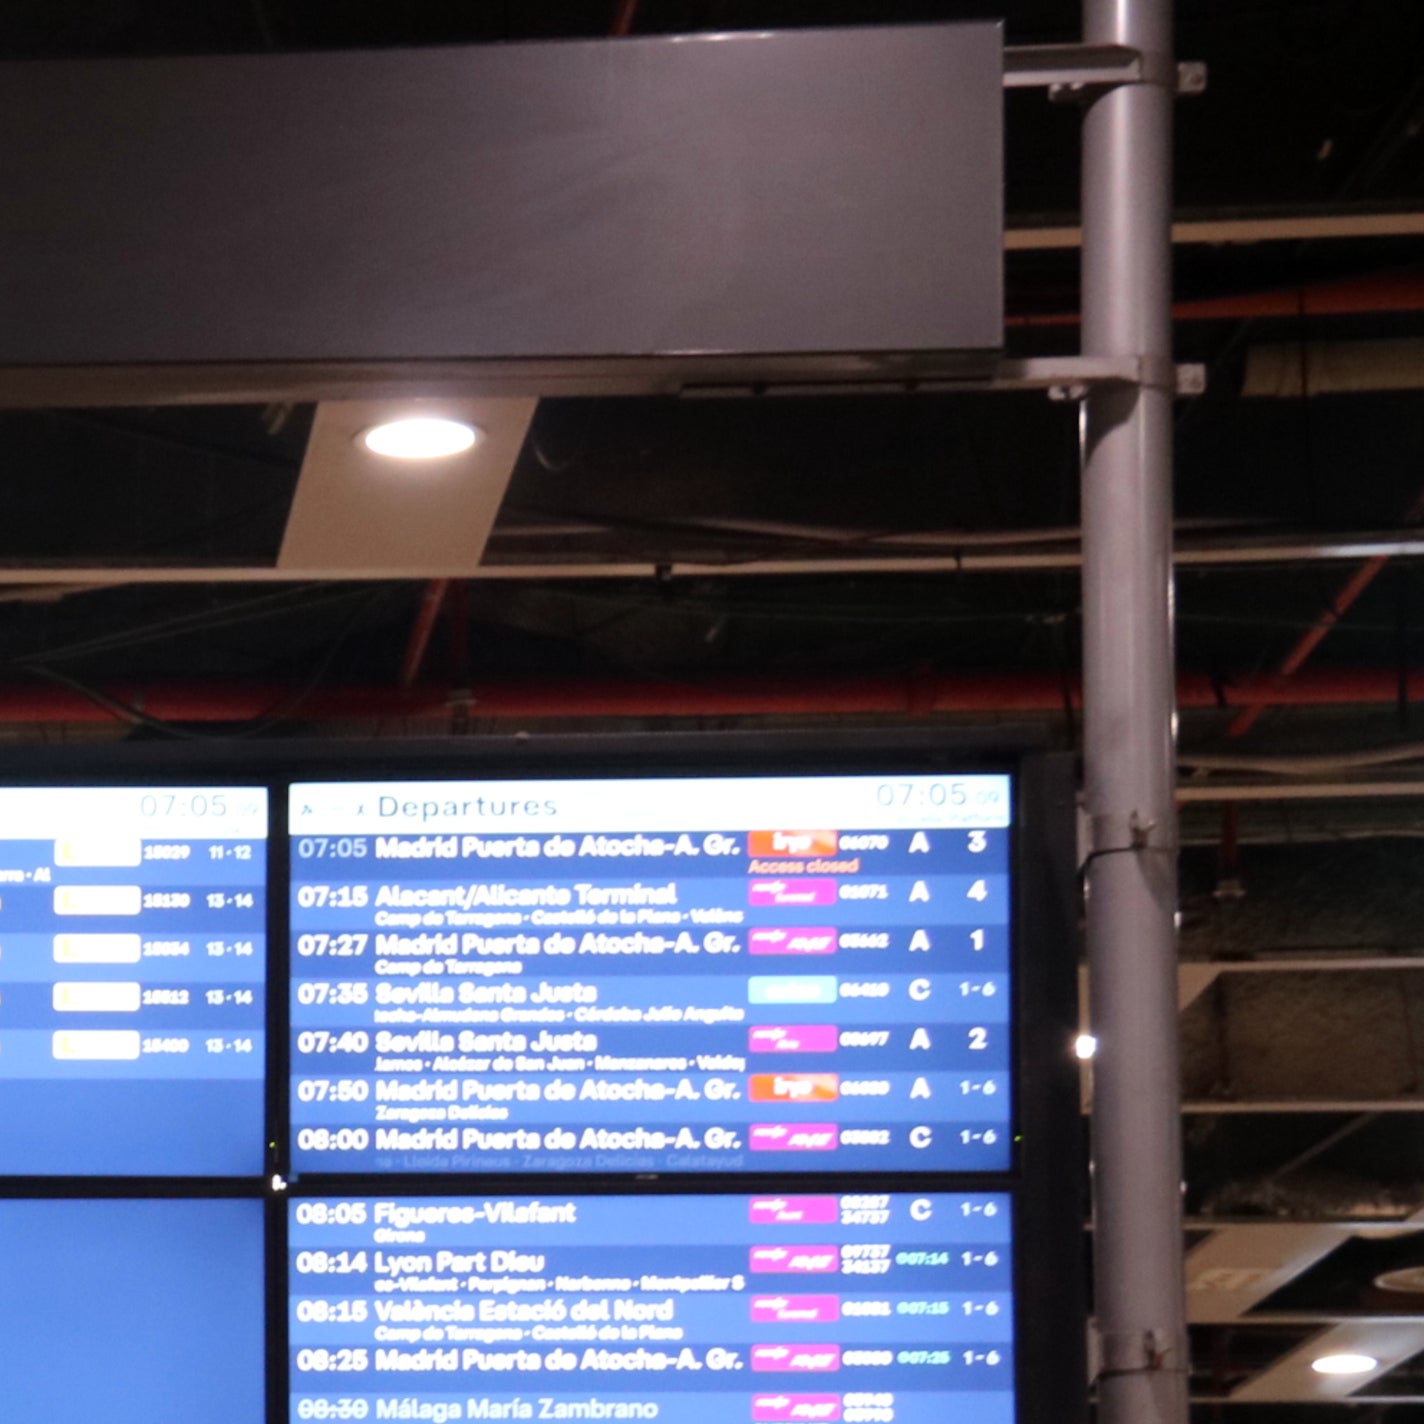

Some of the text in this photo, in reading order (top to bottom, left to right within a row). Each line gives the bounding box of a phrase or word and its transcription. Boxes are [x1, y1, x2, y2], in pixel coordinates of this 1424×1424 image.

[378, 796, 558, 821] Departures
[299, 838, 367, 857] 07:05
[375, 1252, 432, 1277] Lyon
[437, 1251, 486, 1272] Part
[377, 1398, 658, 1423] Málaga María Zambrano
